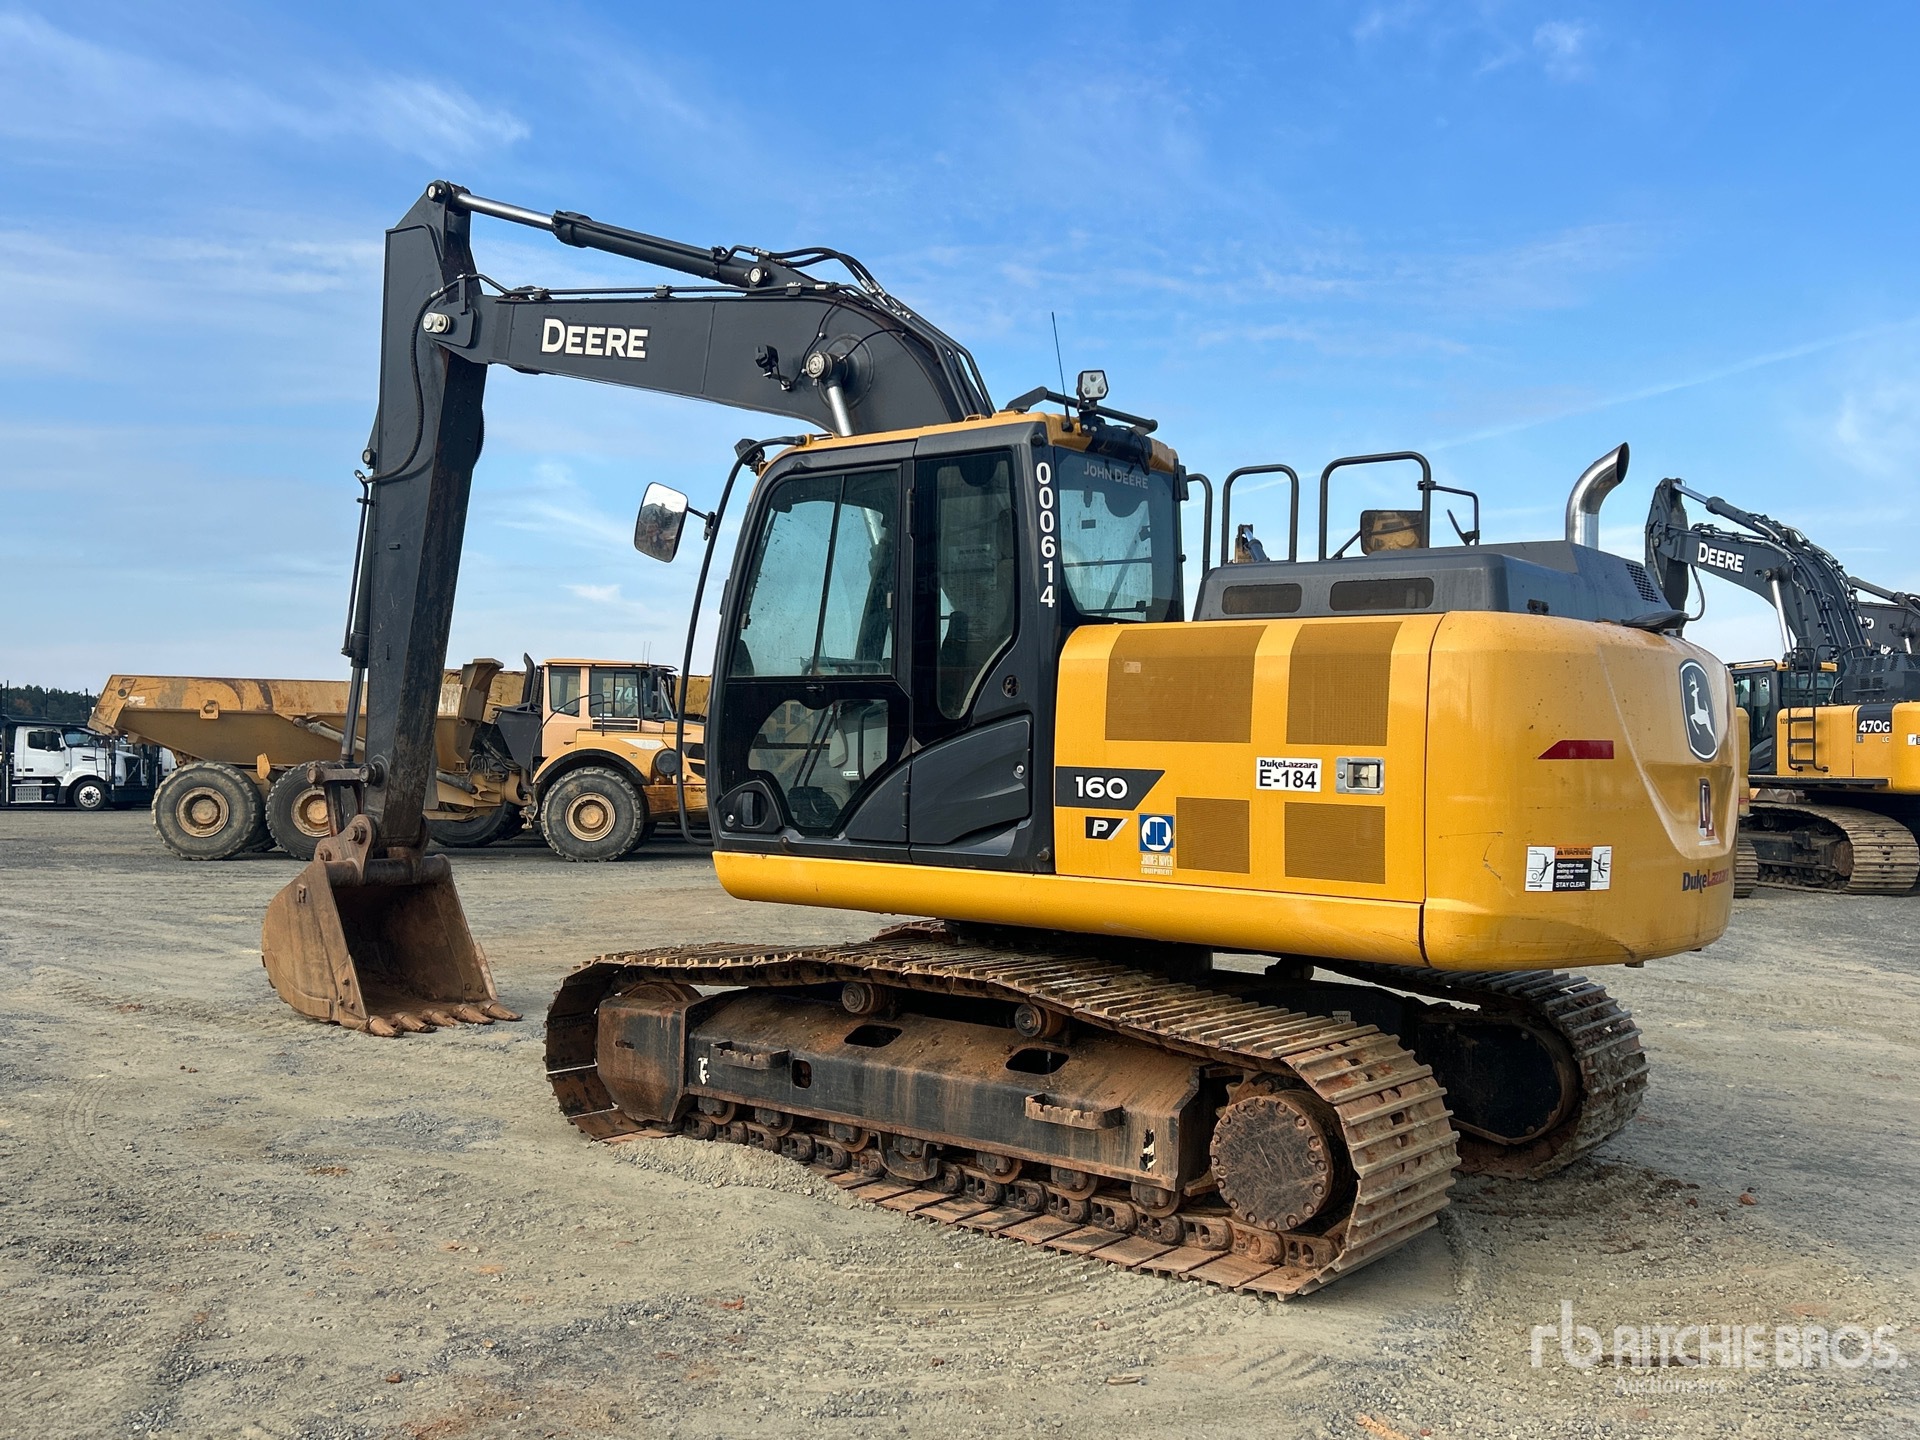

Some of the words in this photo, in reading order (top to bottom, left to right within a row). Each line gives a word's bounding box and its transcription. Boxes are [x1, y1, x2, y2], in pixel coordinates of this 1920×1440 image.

[541, 318, 649, 359] DEERE
[1083, 461, 1113, 481] JOHN
[1114, 468, 1149, 489] DEERE
[1036, 462, 1056, 608] 000614
[1698, 542, 1744, 573] DEERE
[1859, 720, 1891, 733] 470G
[1259, 759, 1318, 770] DukeLazzara
[1075, 776, 1129, 800] 160
[1259, 769, 1317, 789] E-184
[1092, 819, 1109, 837] P
